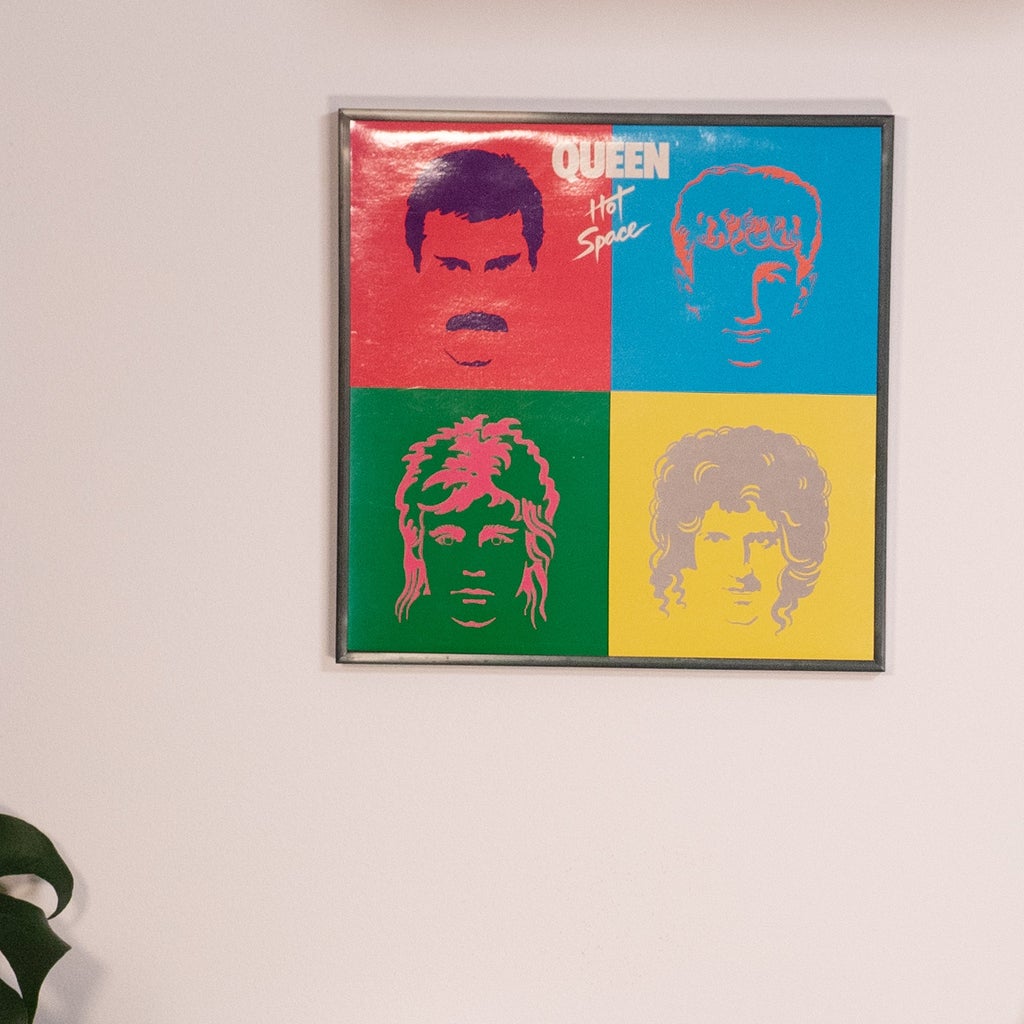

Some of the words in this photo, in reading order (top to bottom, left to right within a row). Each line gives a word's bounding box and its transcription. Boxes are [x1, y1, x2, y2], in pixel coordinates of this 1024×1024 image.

[552, 141, 670, 183] QUEEN
[585, 185, 635, 224] Hot
[572, 221, 652, 264] Space
